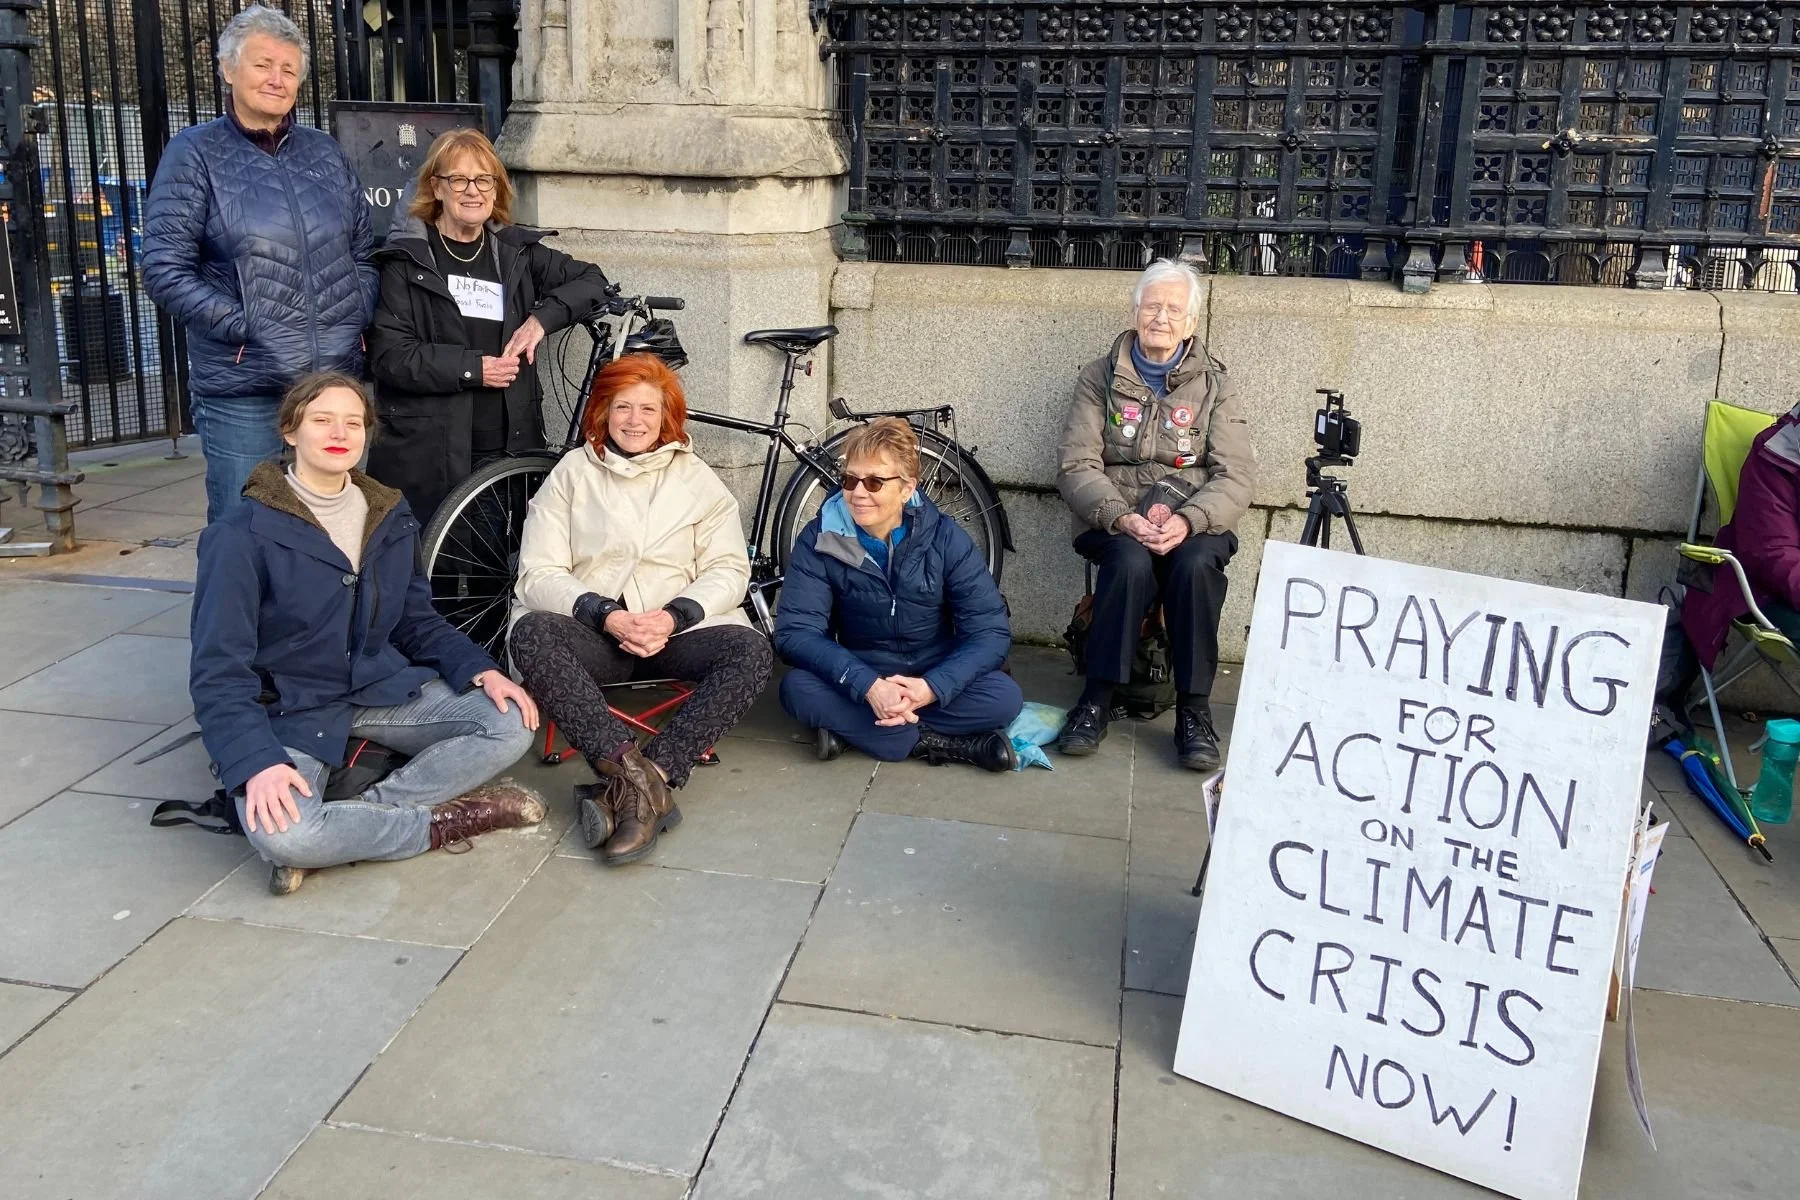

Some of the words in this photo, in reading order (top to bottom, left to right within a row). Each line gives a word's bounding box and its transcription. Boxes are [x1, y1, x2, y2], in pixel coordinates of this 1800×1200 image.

[364, 187, 391, 208] NO
[1281, 578, 1630, 716] PRAYING
[1399, 699, 1496, 753] FOR
[1276, 722, 1576, 849] ACTION
[1269, 841, 1593, 975] CLIMATE
[1361, 819, 1413, 850] ON
[1445, 838, 1518, 882] THE
[1250, 929, 1543, 1066] CRISIS
[1326, 1045, 1517, 1151] NOW!
